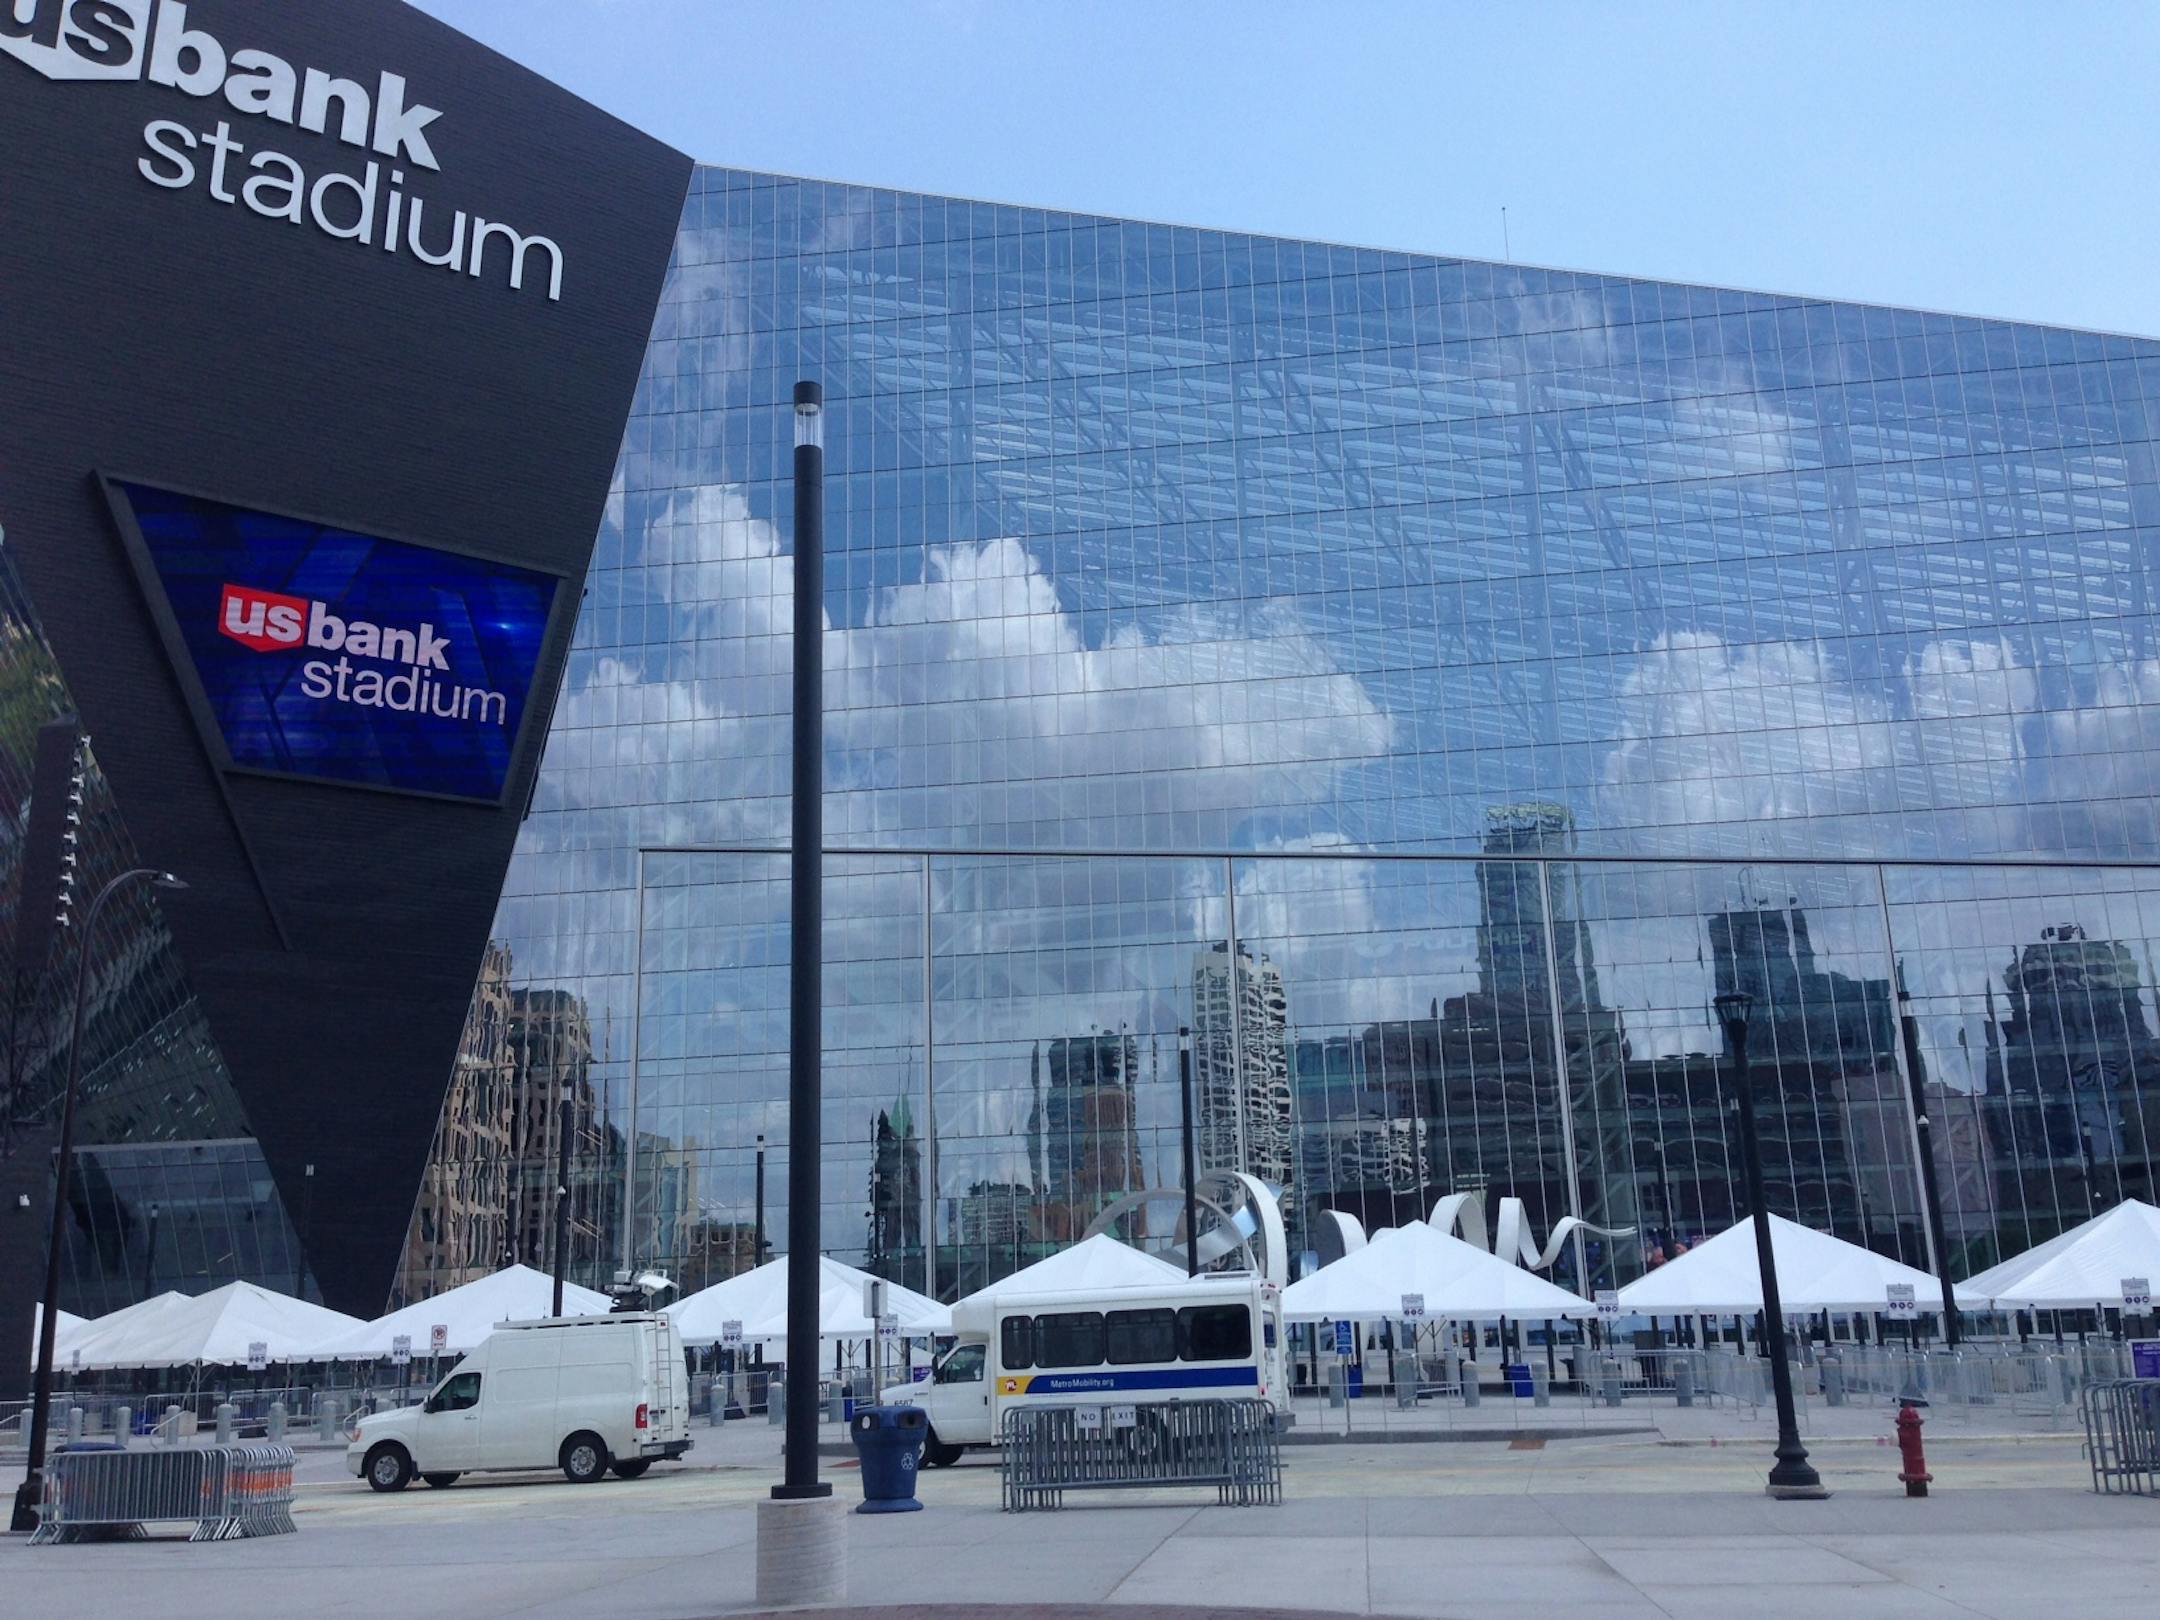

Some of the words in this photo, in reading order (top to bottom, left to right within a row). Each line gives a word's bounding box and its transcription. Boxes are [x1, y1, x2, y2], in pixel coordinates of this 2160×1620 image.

[138, 119, 564, 300] stadium
[301, 656, 507, 725] stadium
[1050, 1378, 1114, 1389] MetroMobility.org
[1081, 1412, 1096, 1421] NO
[1112, 1411, 1134, 1421] EXIT
